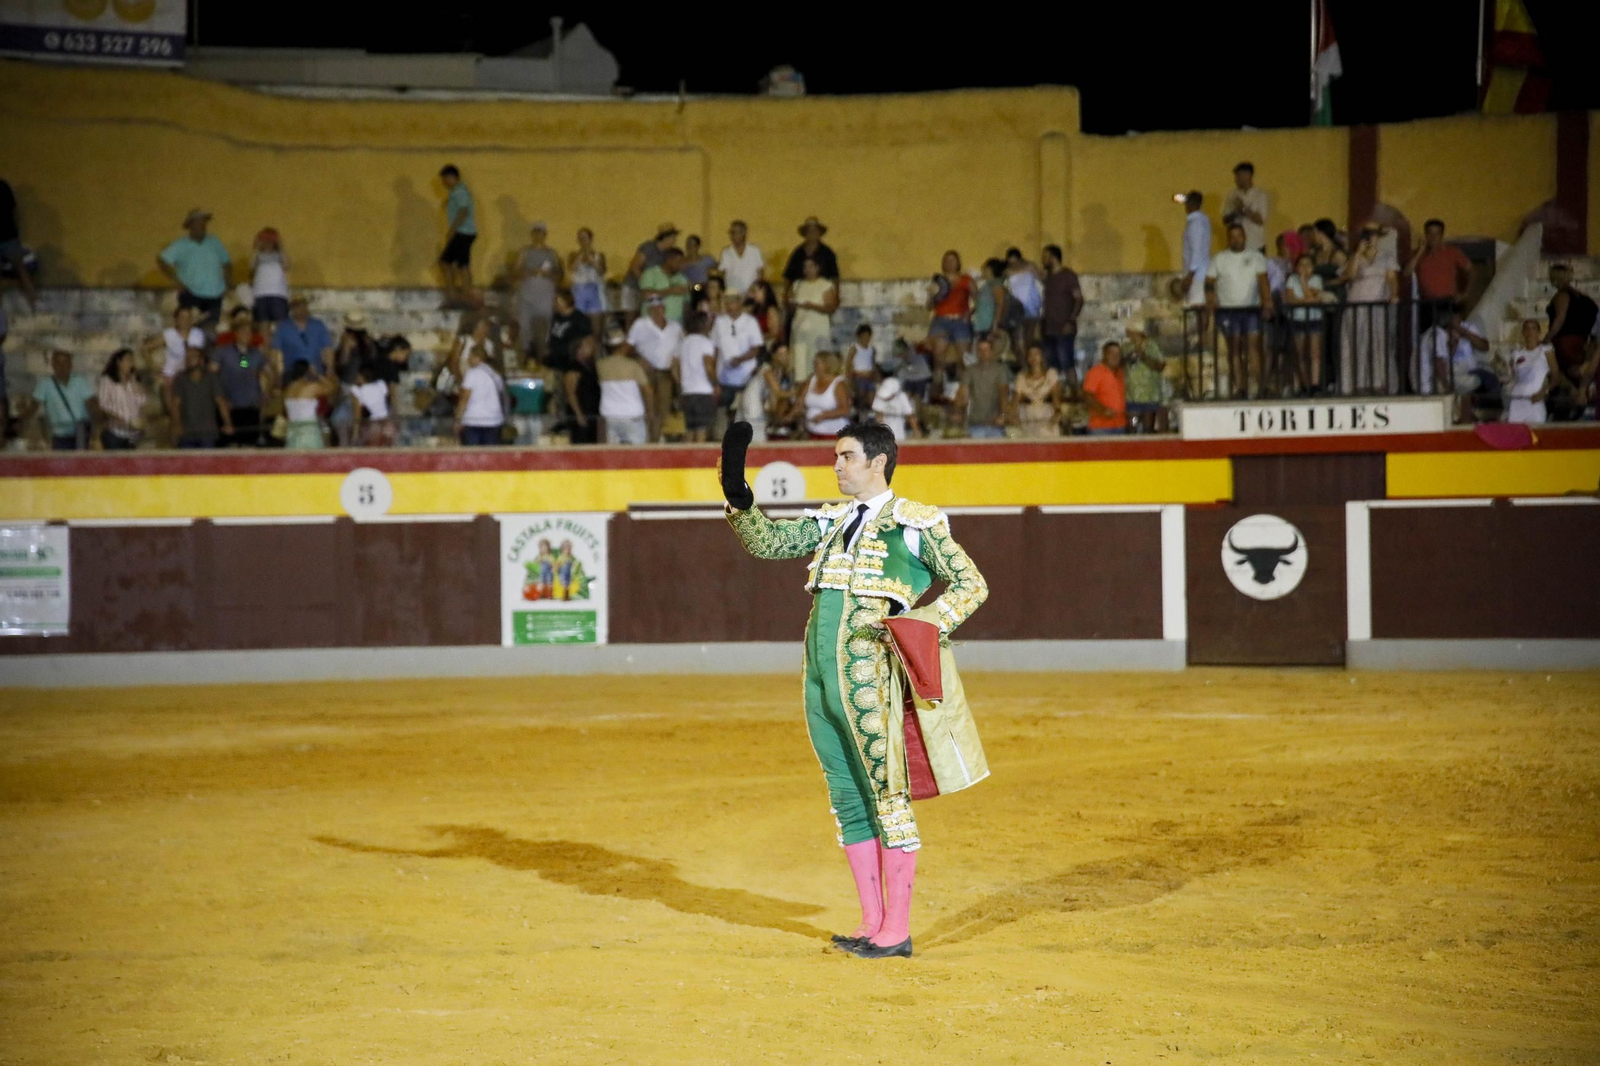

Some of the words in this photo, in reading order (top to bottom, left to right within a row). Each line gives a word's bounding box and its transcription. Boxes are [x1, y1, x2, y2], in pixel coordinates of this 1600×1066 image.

[63, 32, 96, 50] 633
[102, 34, 134, 53] 527
[1233, 403, 1391, 432] TORILES
[507, 519, 552, 564] CASTALA
[555, 518, 600, 550] FRUITS
